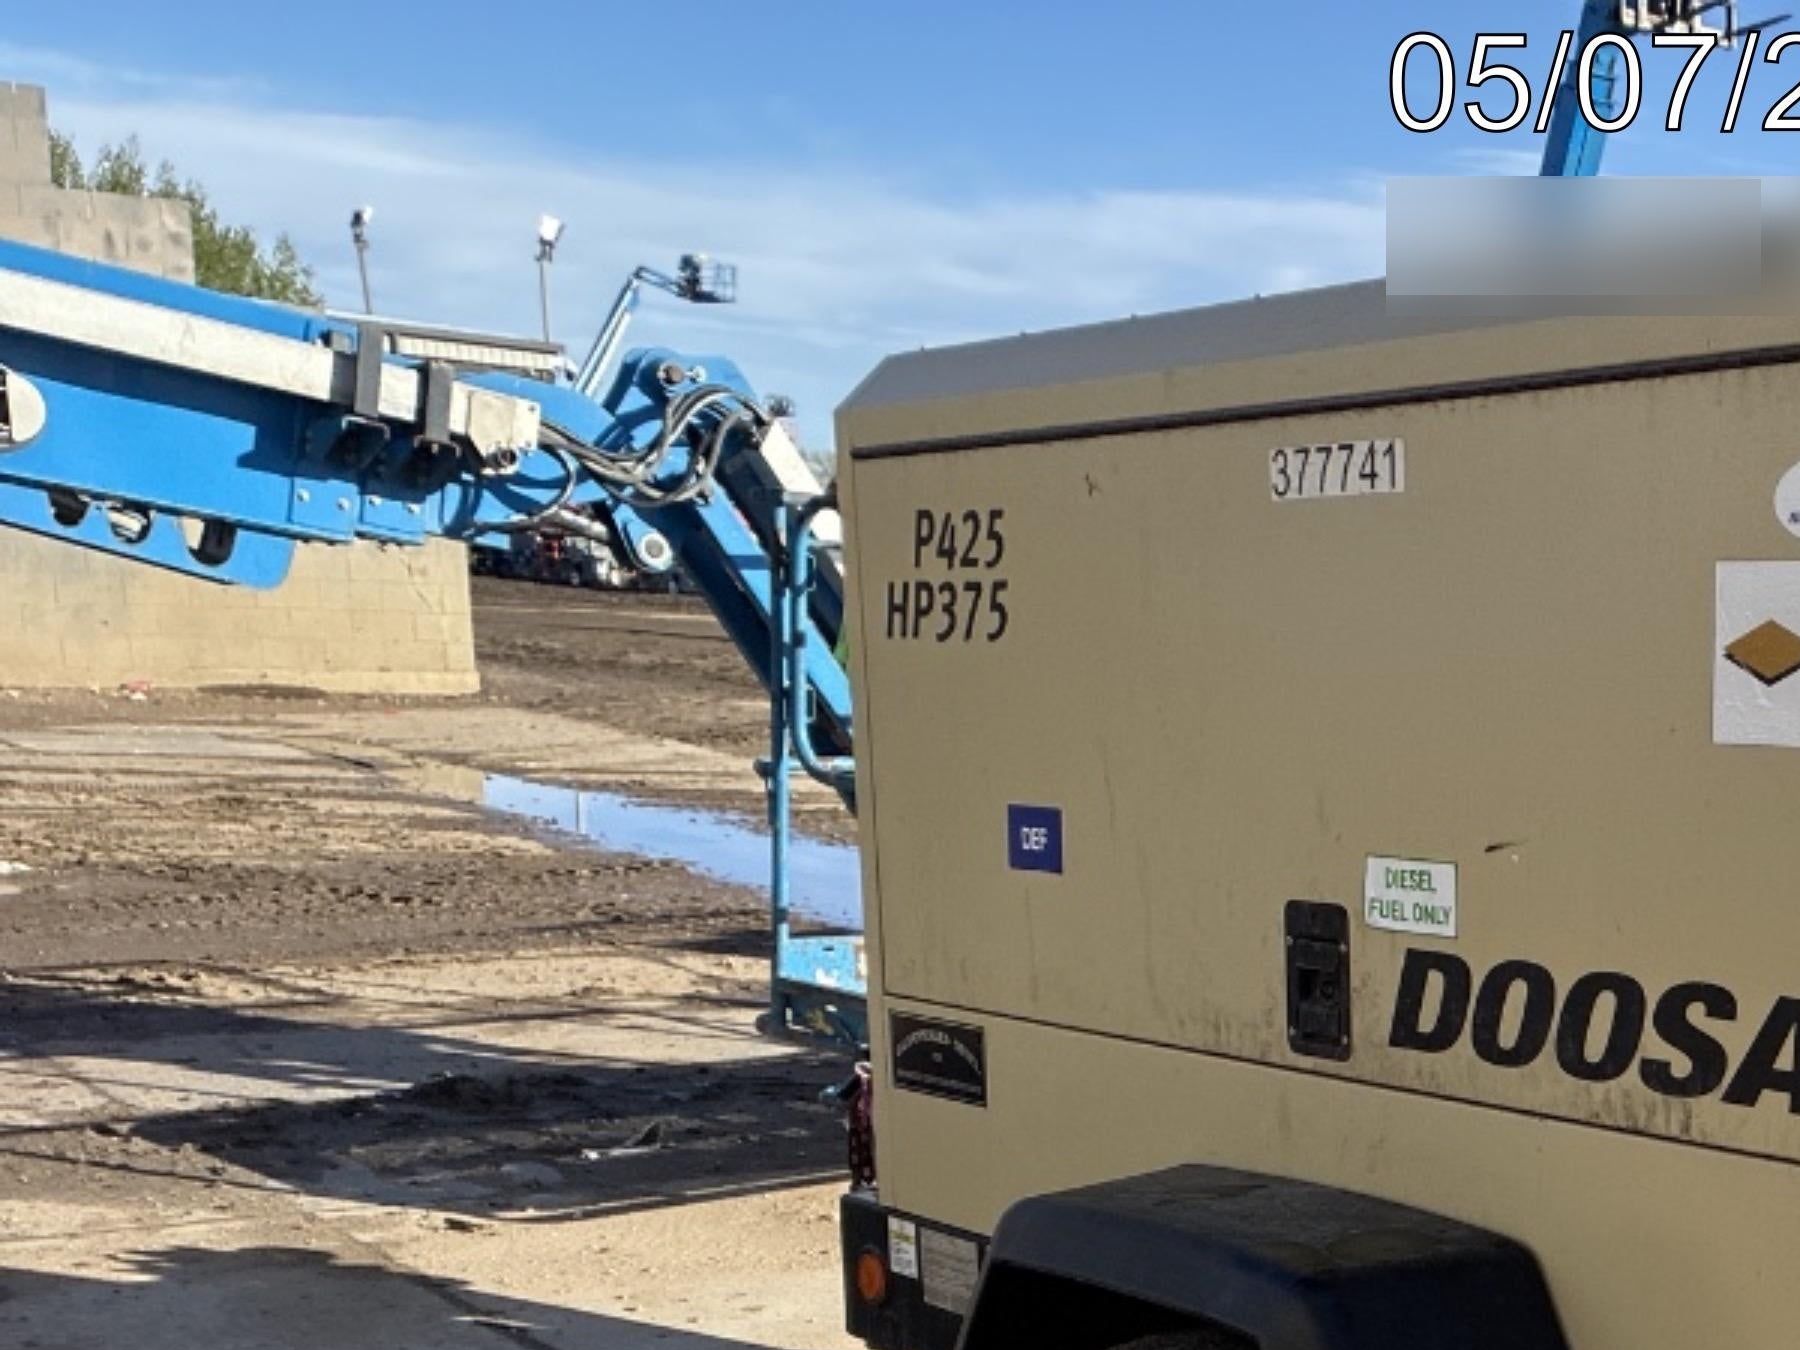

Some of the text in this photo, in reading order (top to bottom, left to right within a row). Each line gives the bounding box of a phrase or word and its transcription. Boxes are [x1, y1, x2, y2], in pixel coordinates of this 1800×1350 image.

[1270, 440, 1398, 498] 377741
[913, 508, 1005, 571] P425
[885, 580, 1009, 643] HP375
[1020, 826, 1048, 852] DEF
[1384, 865, 1438, 895] DIESEL
[1368, 898, 1453, 927] FUEL ONLY
